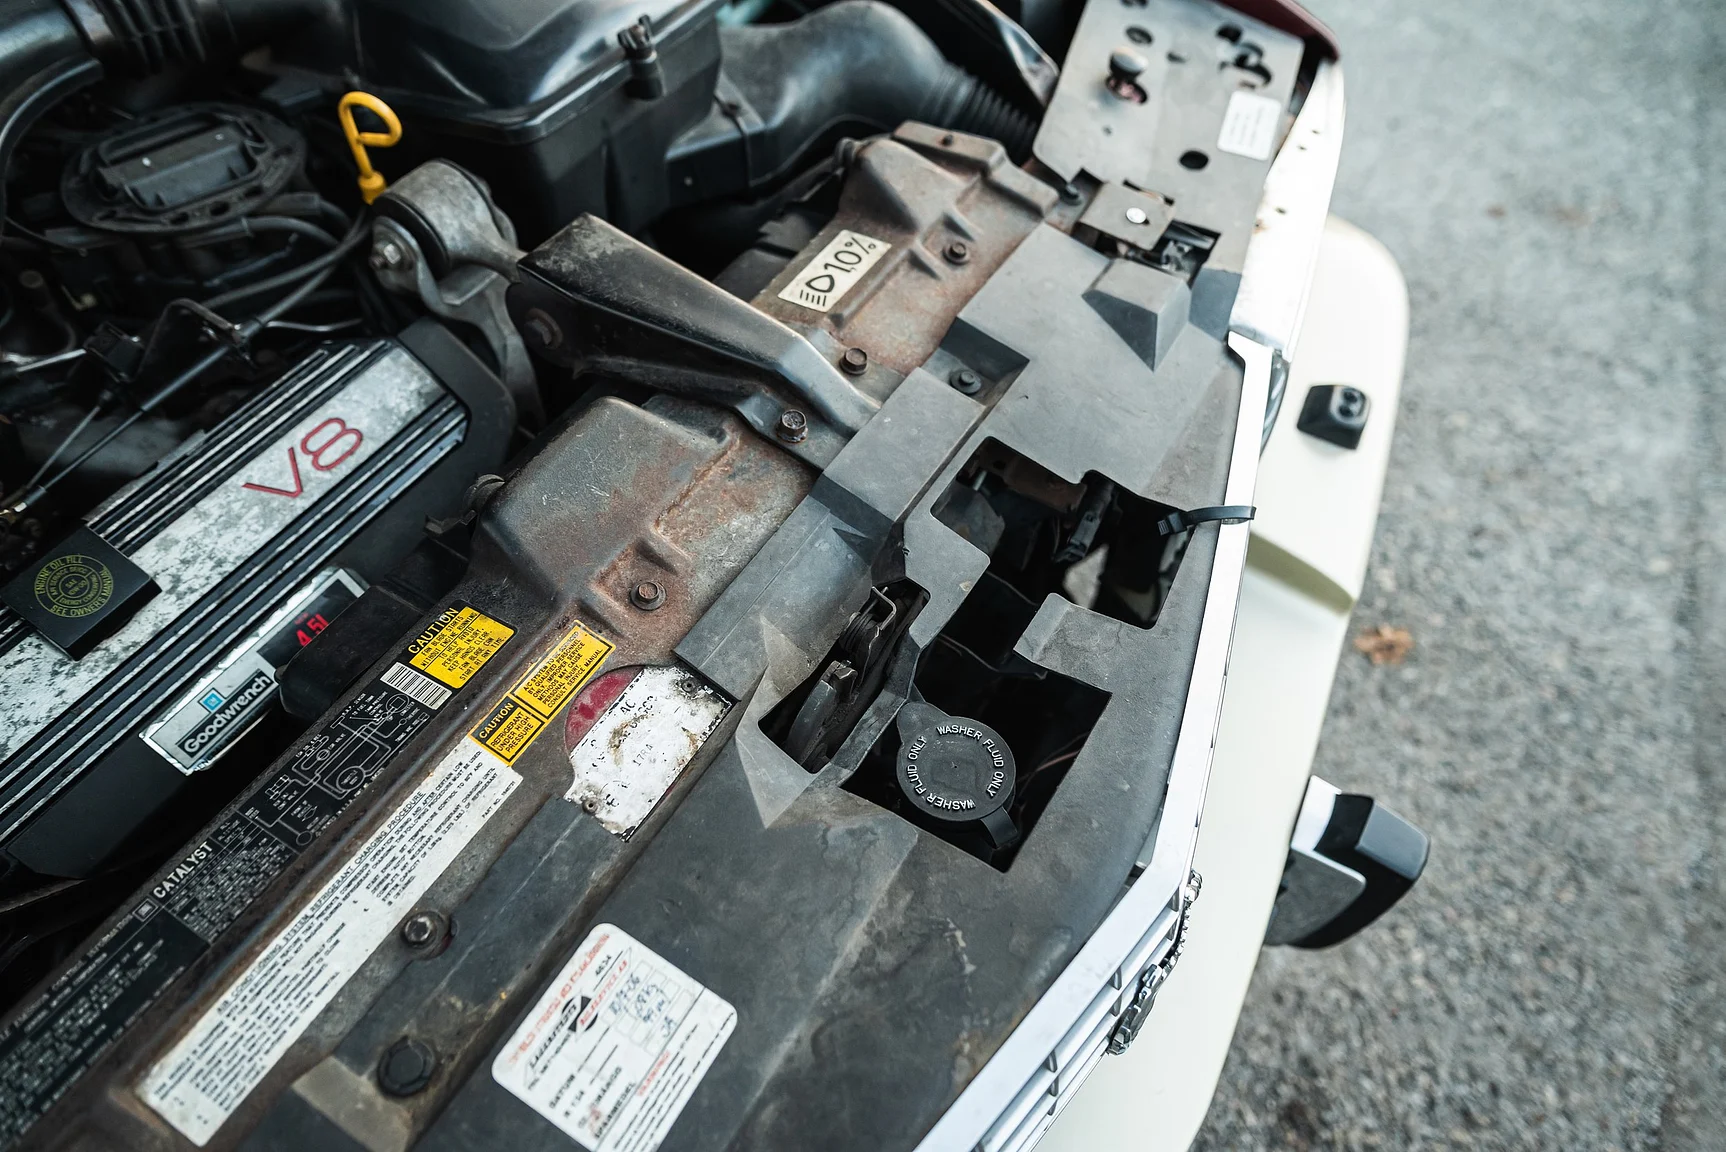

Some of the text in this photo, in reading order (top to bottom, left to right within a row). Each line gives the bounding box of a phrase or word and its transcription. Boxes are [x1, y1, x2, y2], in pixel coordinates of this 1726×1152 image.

[242, 418, 363, 498] V8
[50, 559, 65, 569] OIL
[51, 605, 67, 616] SEE
[406, 607, 459, 654] CAUTION
[419, 611, 477, 666] WITHOUT ENGINE RUNNING
[420, 615, 463, 656] FAN BLADE STARTS
[446, 641, 459, 652] HELP
[458, 626, 474, 640] AVOID
[458, 636, 494, 670] FAN BLADE CAN
[441, 646, 464, 667] PERSONAL
[447, 660, 461, 672] KEEP
[459, 645, 475, 659] HANDS
[459, 666, 475, 680] START
[480, 649, 492, 658] ANY
[522, 681, 533, 691] A/C
[530, 664, 548, 682] SYSTEM
[546, 657, 554, 665] TO
[527, 637, 580, 694] BY QUALIFIED PERSONNEL
[537, 652, 582, 701] METHODS MAY CAUSE
[545, 660, 567, 683] IMPROPER
[566, 641, 585, 660] SERVICE
[542, 680, 565, 705] PERSONAL
[547, 686, 568, 708] CONSULT
[566, 665, 586, 686] SERVICE
[184, 676, 270, 752] Goodwrench
[478, 701, 514, 739] CAUTION
[490, 711, 524, 747] REFRIGERANT
[496, 715, 530, 751] UNDER HIGH
[505, 722, 533, 752] PRESSURE
[907, 736, 976, 810] WASHER FLUID ONLY
[937, 725, 1004, 798] WASHER FLUID ONLY
[395, 833, 405, 843] THE
[404, 808, 428, 834] FOLLOWING
[428, 781, 452, 808] PROCEDURE
[451, 769, 464, 782] MUST
[437, 789, 457, 811] CONTROL
[457, 781, 464, 789] TO
[473, 761, 483, 771] AND
[339, 862, 370, 895] COMPRESSOR
[369, 836, 394, 863] OPERATION
[394, 817, 412, 835] DURING
[411, 805, 422, 816] AND
[421, 791, 435, 806] AFTER
[435, 772, 453, 791] CERTAIN
[452, 761, 463, 772] LOW
[481, 806, 493, 818] PART
[153, 842, 213, 898] CATALYST
[216, 999, 230, 1014] AIR
[229, 942, 282, 998] CONDITIONING
[282, 913, 309, 942] SYSTEM
[309, 865, 354, 912] REFRIGERANT
[353, 829, 387, 865] CHARGING
[386, 790, 423, 829] PROCEDURE
